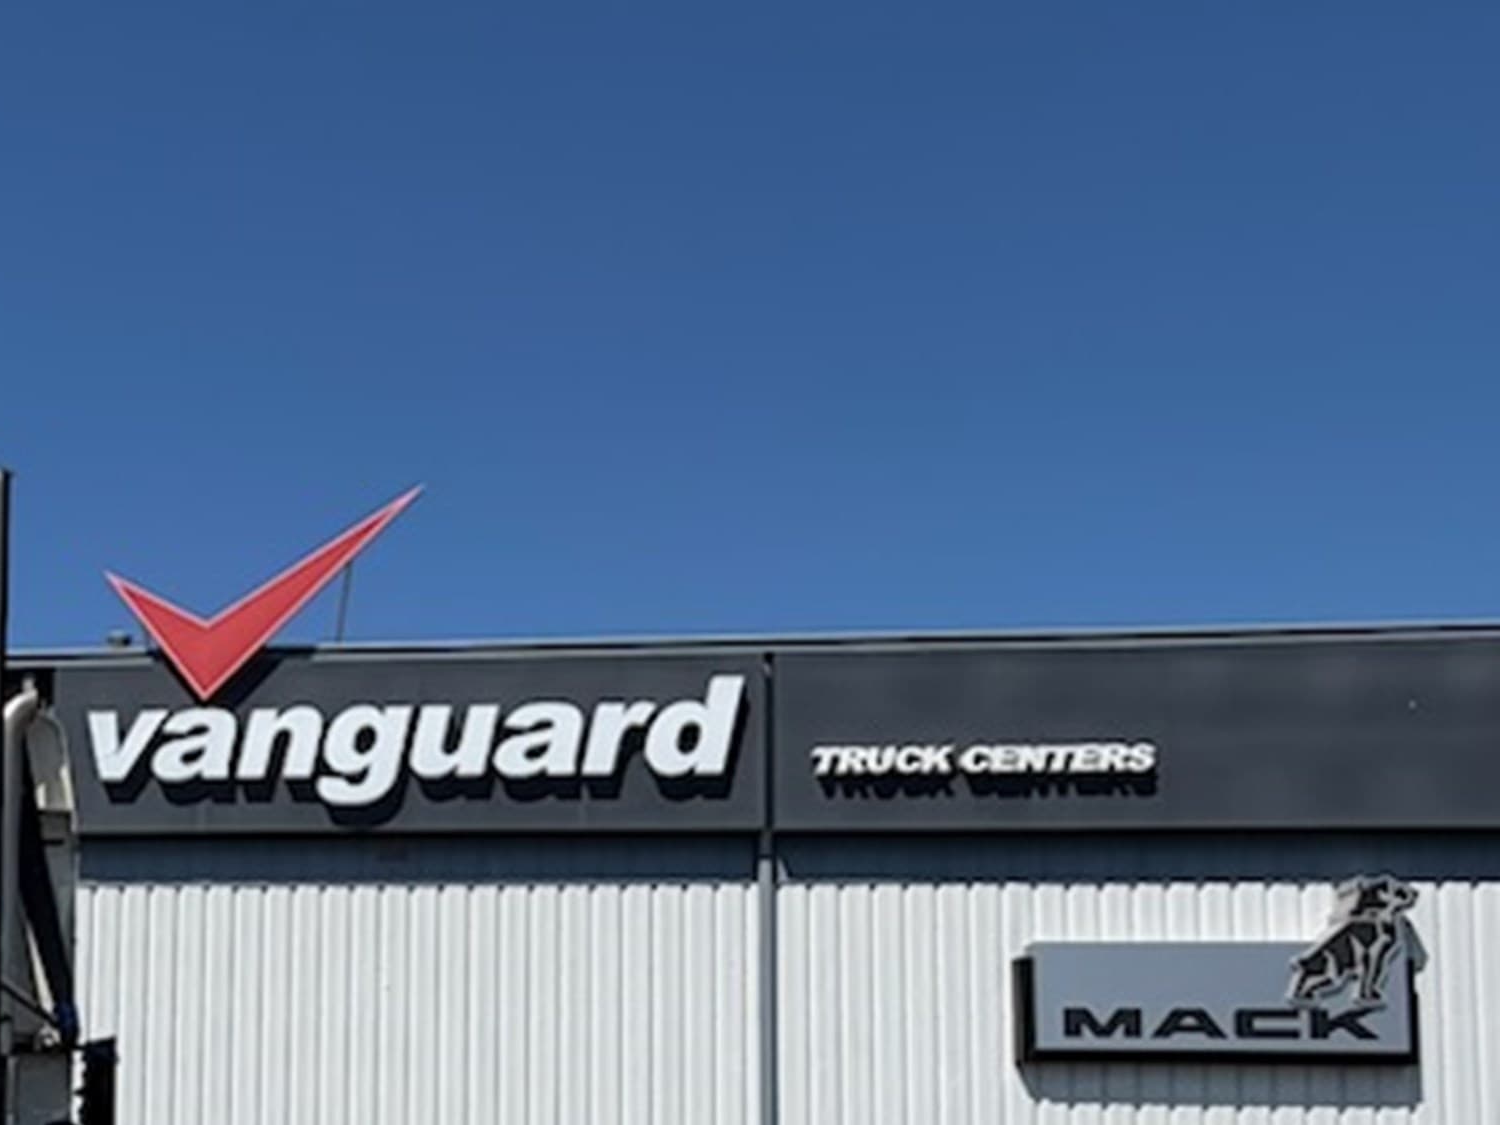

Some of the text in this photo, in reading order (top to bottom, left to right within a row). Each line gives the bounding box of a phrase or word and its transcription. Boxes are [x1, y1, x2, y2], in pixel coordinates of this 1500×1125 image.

[88, 674, 745, 804] vanguard
[811, 743, 1156, 776] TRUCK CENTERS
[1063, 1007, 1379, 1040] MACK
